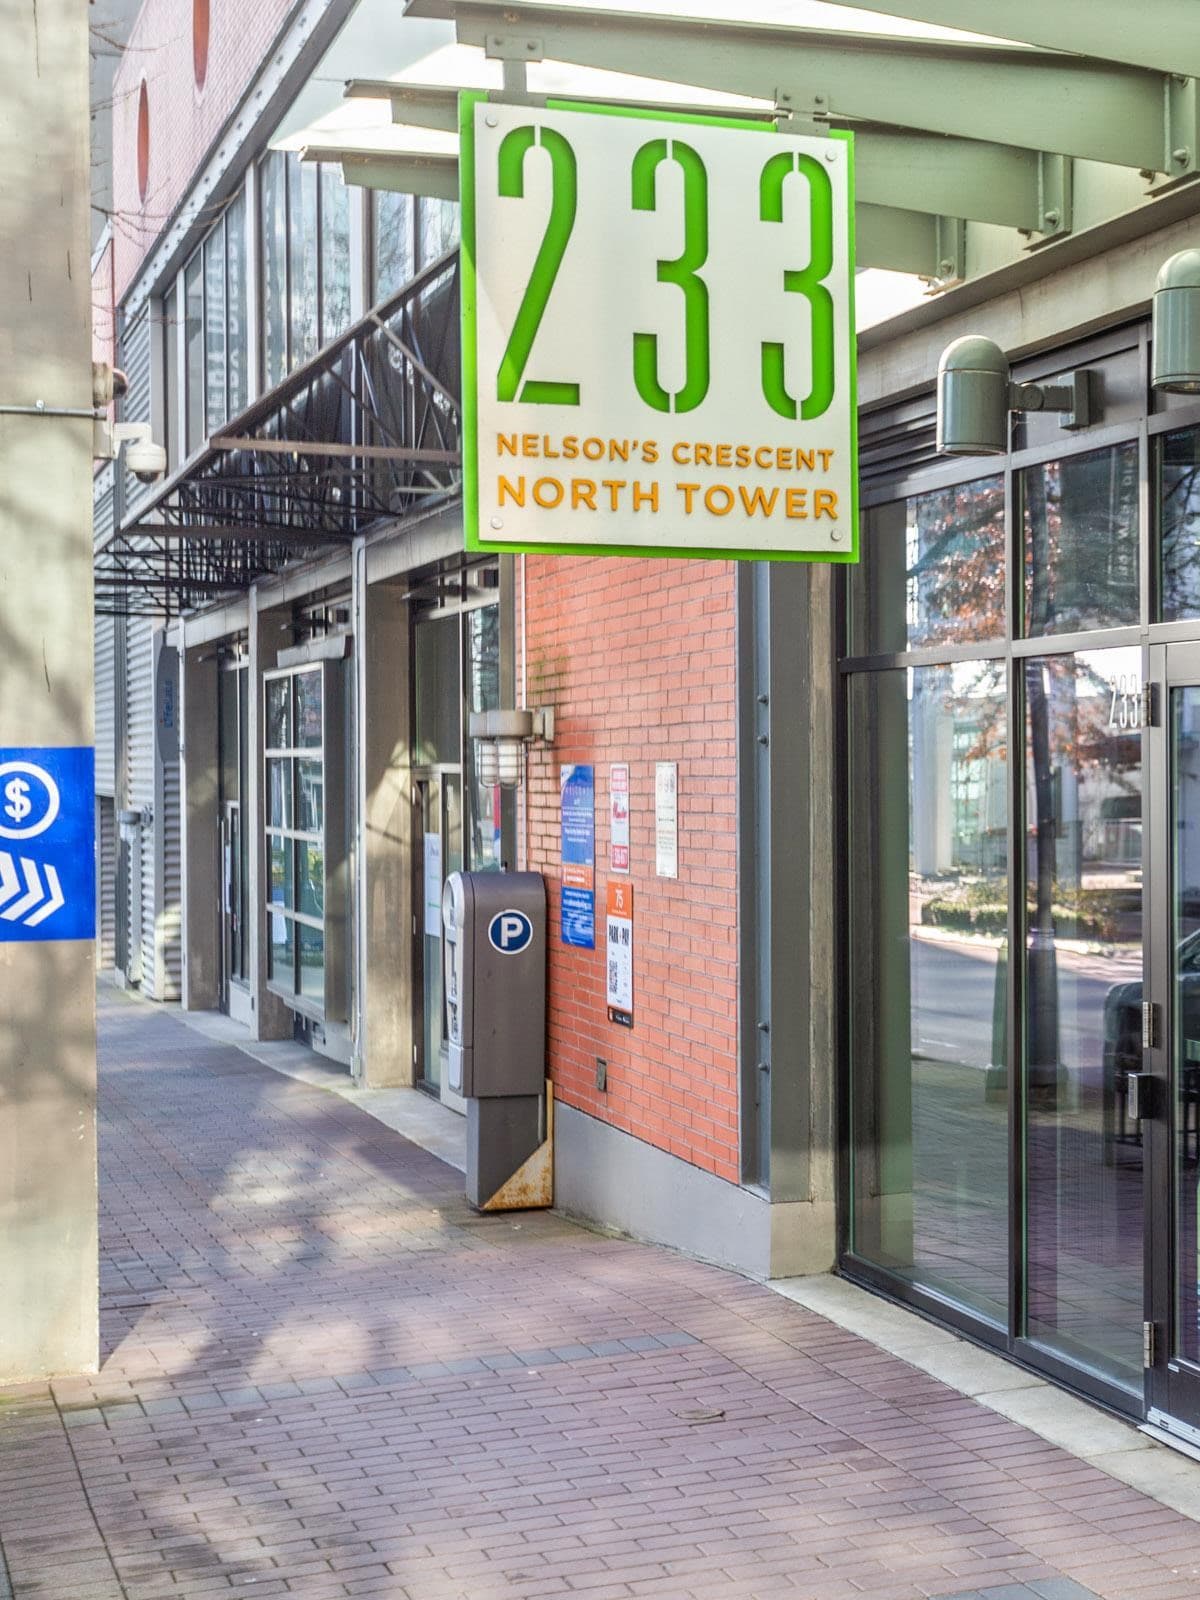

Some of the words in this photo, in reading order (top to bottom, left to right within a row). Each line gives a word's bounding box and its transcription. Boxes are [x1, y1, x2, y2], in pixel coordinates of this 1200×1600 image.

[497, 125, 835, 420] 233
[497, 432, 660, 463] NELSON'S
[672, 441, 834, 471] CRESCENT
[497, 475, 660, 513] NORTH
[676, 483, 839, 520] TOWER
[1109, 674, 1138, 728] 233
[501, 916, 524, 948] P
